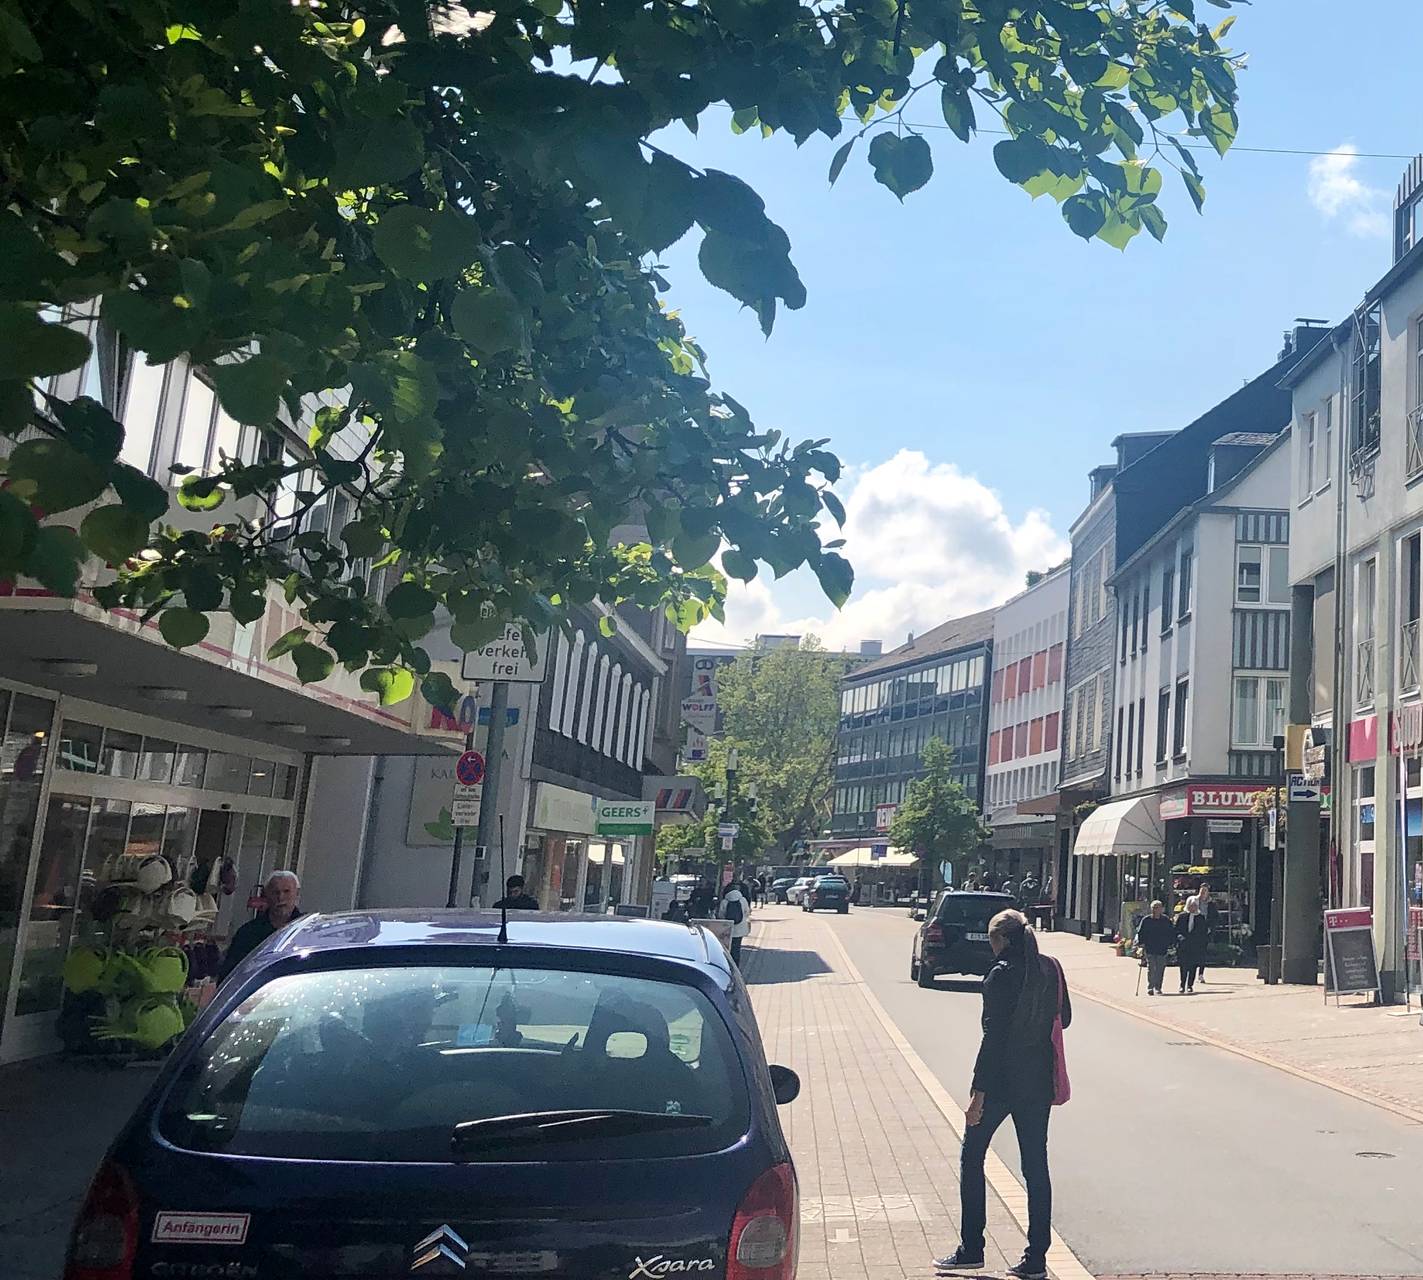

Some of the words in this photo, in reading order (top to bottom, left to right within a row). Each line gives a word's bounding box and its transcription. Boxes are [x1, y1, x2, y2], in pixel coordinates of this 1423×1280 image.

[477, 644, 529, 659] verkeh
[492, 661, 519, 675] frei
[682, 703, 716, 712] WOLFF
[1192, 790, 1254, 806] BLUM
[602, 807, 641, 818] GEERS
[628, 1254, 716, 1280] Xsara
